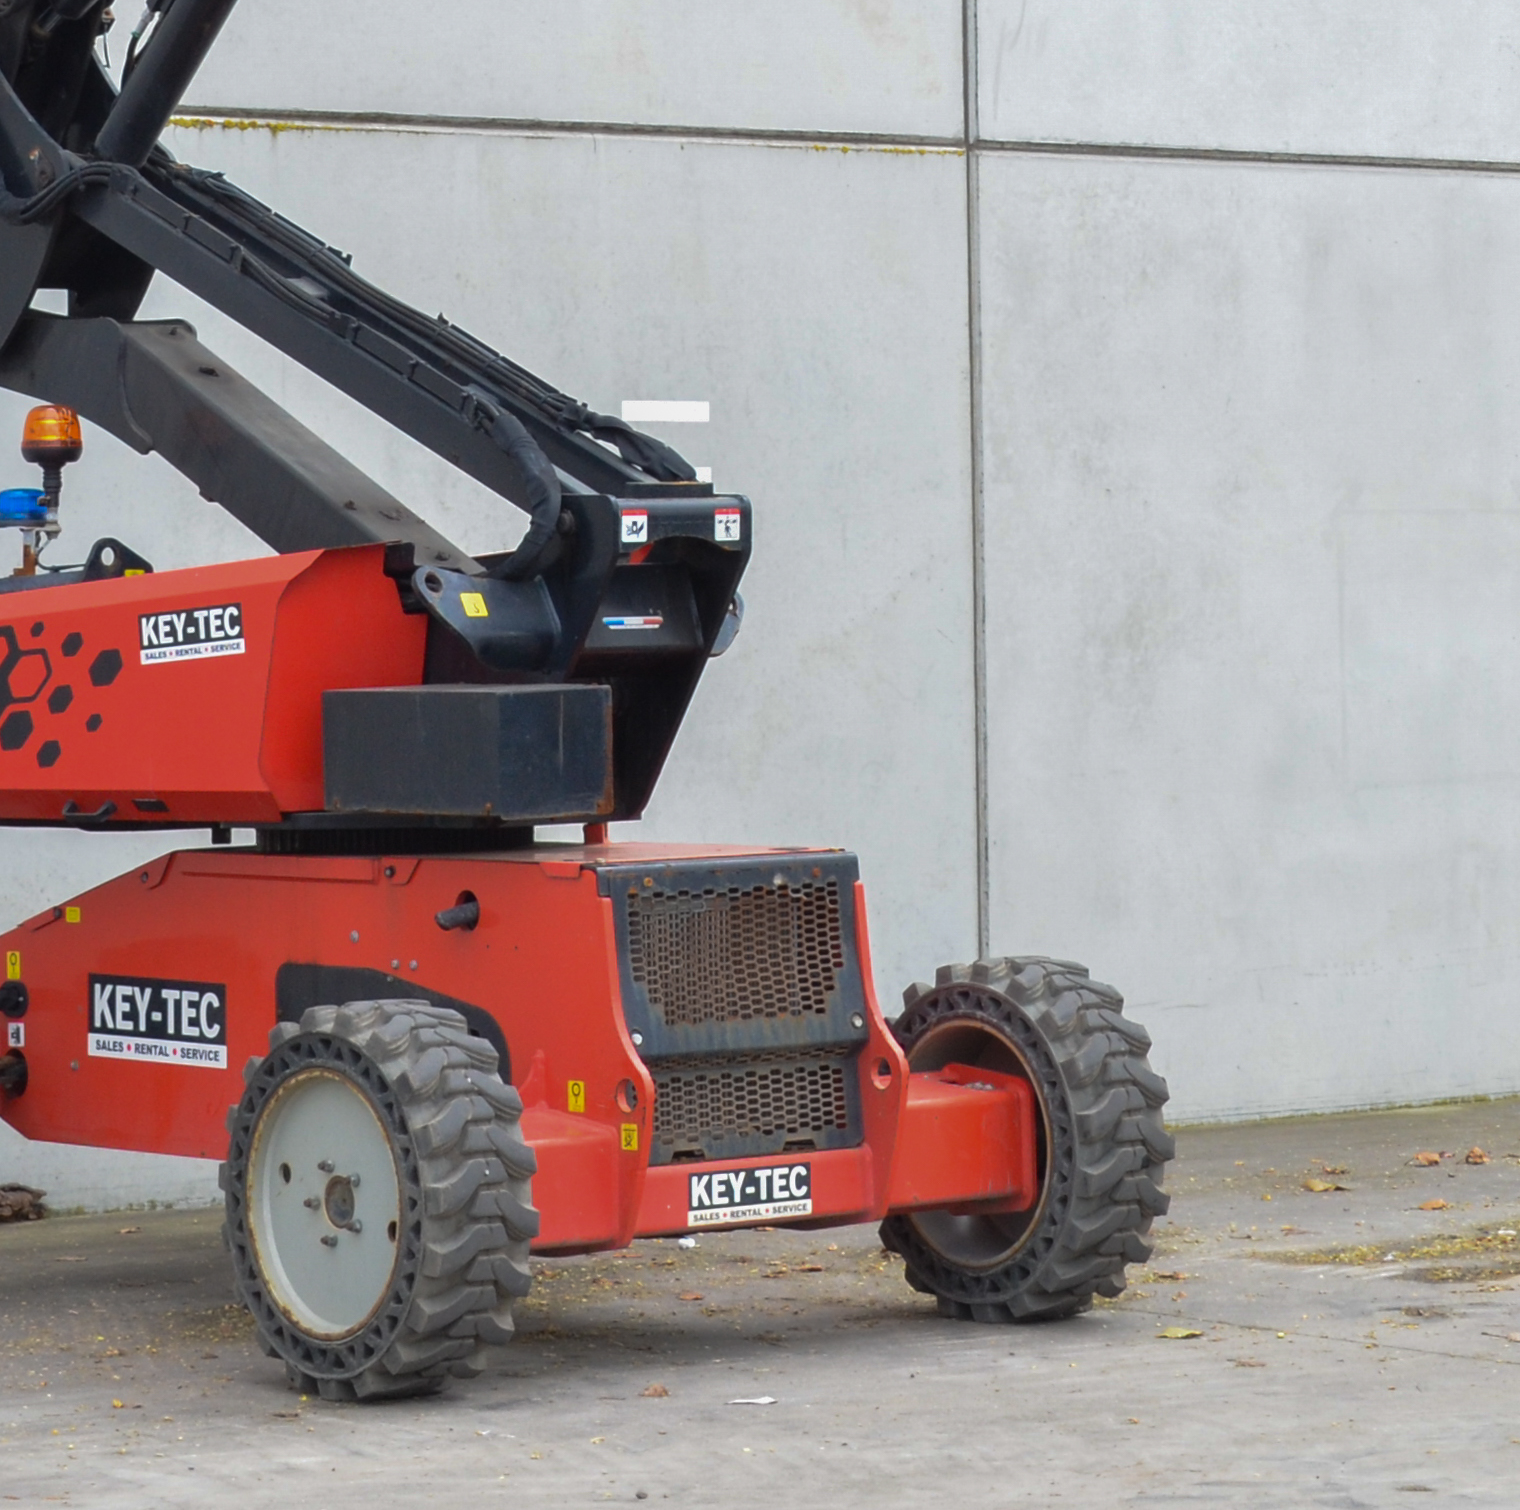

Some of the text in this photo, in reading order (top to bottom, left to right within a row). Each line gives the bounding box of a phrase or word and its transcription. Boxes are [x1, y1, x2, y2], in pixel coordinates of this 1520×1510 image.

[141, 606, 241, 646] KEY-TEC
[145, 642, 240, 660] SALES RENTAL SERVICE
[94, 983, 221, 1039] KEY-TEC
[95, 1039, 220, 1062] SALES RENTAL SERVICE
[691, 1165, 808, 1207] KEY-TEC
[693, 1203, 808, 1222] SALES RENTAL SERVICE
